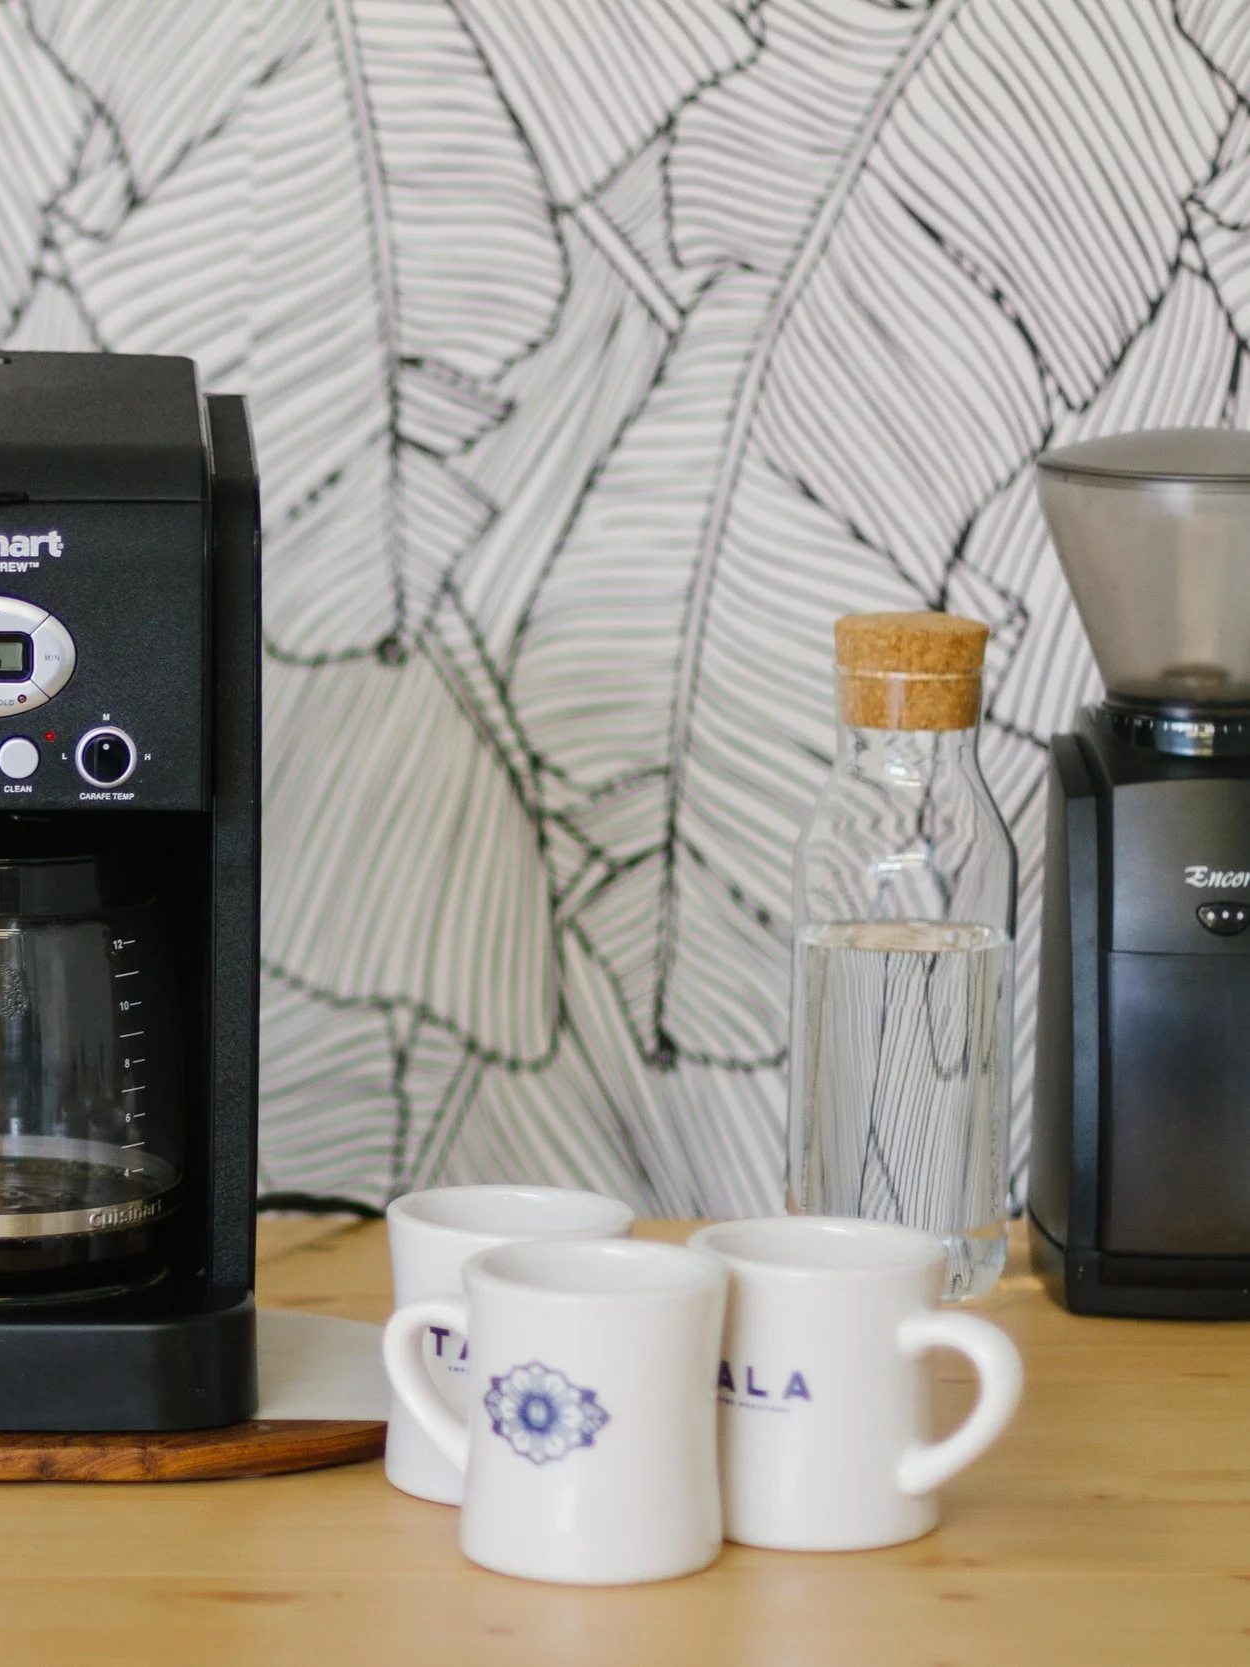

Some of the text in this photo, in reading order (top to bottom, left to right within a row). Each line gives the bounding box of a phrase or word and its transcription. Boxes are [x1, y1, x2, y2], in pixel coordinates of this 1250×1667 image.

[44, 654, 61, 662] MIN
[102, 713, 110, 721] M
[62, 752, 68, 760] L
[144, 753, 151, 761] H
[3, 784, 33, 793] CLEAN
[79, 791, 135, 801] CARAFE TEMP
[112, 938, 124, 950] 12
[119, 1000, 129, 1011] 10
[124, 1058, 130, 1069] 8
[125, 1112, 131, 1123] 6
[123, 1167, 130, 1178] 4
